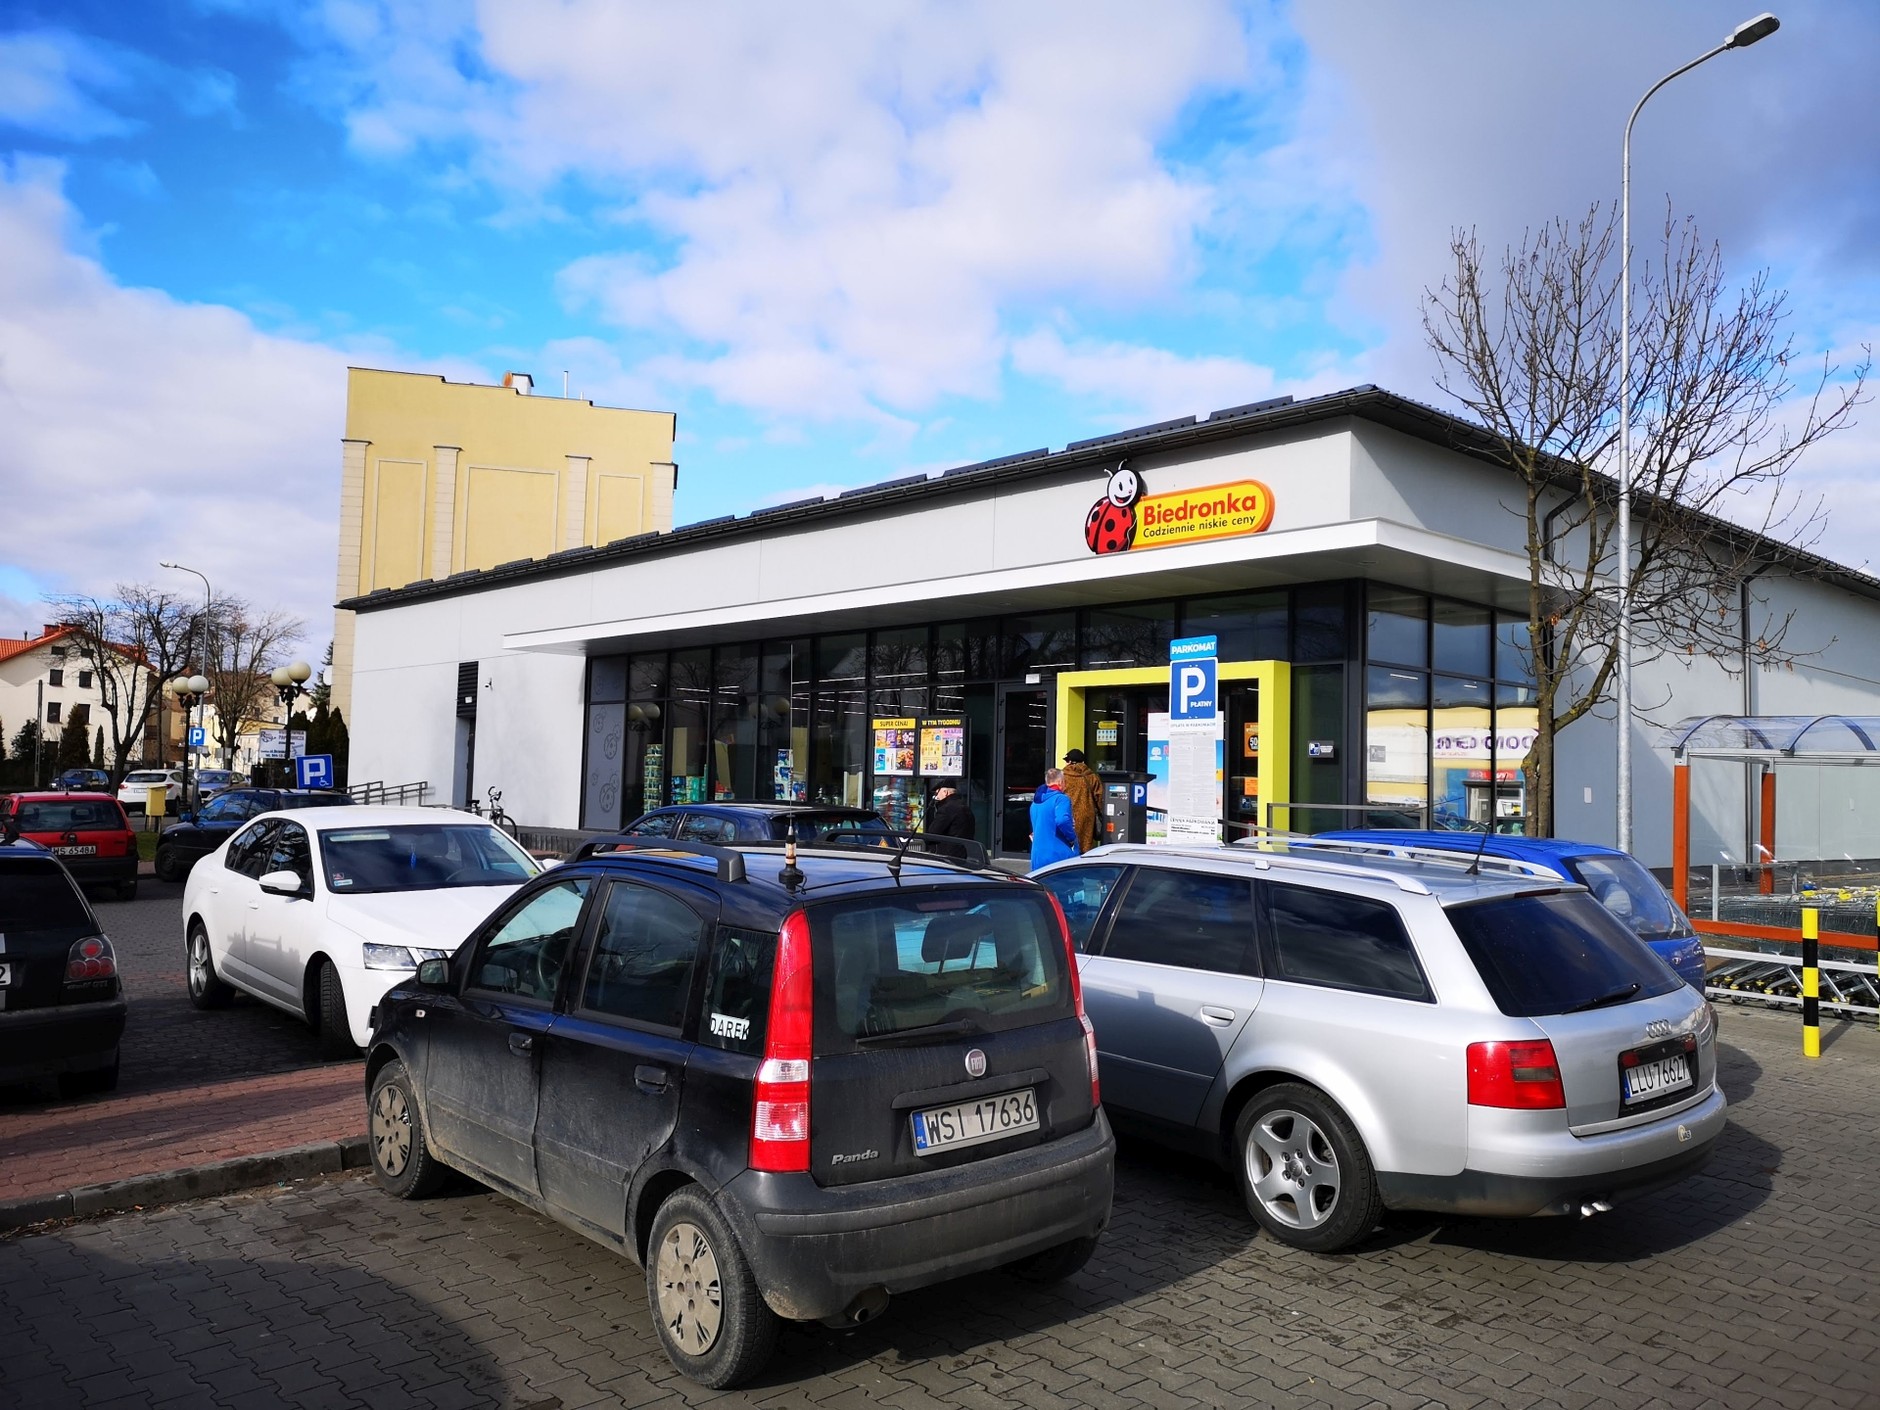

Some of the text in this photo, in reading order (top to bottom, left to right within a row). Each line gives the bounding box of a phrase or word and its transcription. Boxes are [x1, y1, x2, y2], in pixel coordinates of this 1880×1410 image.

[1143, 493, 1256, 526] Biedronka
[1143, 515, 1256, 538] Codziennie niskie ceny
[1171, 641, 1216, 655] PARKOMAT
[1181, 667, 1206, 714] P
[1190, 700, 1213, 708] PŁATNY
[193, 729, 202, 743] P
[303, 758, 326, 785] P
[1134, 785, 1145, 803] P
[53, 847, 66, 855] WS
[710, 1017, 750, 1040] DAREK
[970, 1056, 983, 1070] FIAT
[1627, 1055, 1686, 1094] LLU 76627
[925, 1093, 1034, 1145] WSI 17636
[916, 1136, 926, 1144] PL
[831, 1149, 879, 1165] Panda
